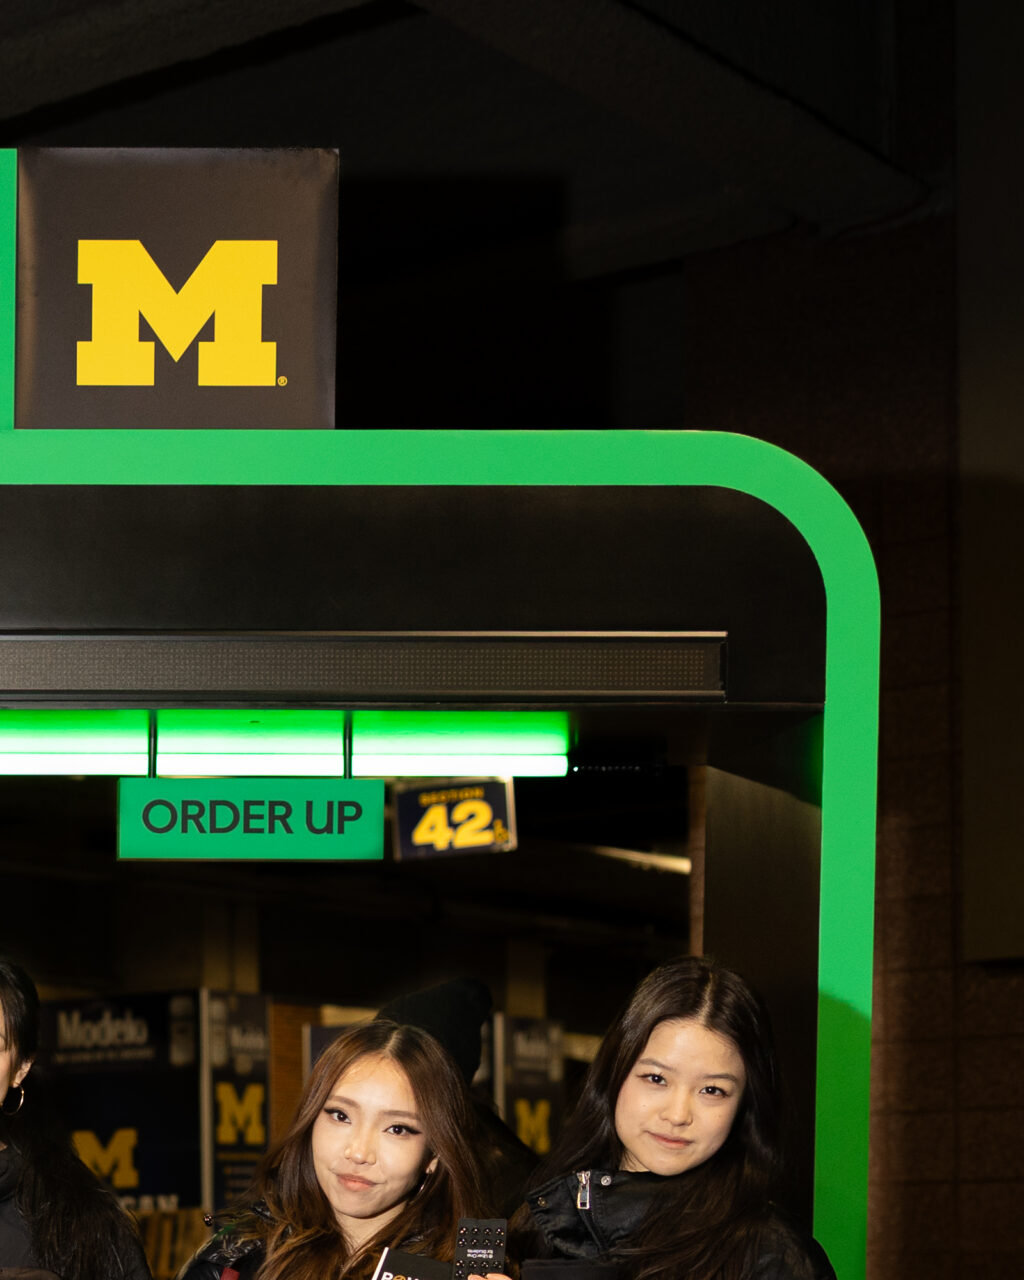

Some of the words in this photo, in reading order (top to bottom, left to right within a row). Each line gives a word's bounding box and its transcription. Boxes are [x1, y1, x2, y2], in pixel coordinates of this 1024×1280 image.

[76, 239, 279, 387] M
[142, 799, 293, 835] ORDER
[305, 799, 363, 835] UP
[411, 798, 494, 851] 42
[57, 1008, 149, 1049] Modelo
[214, 1082, 266, 1146] M
